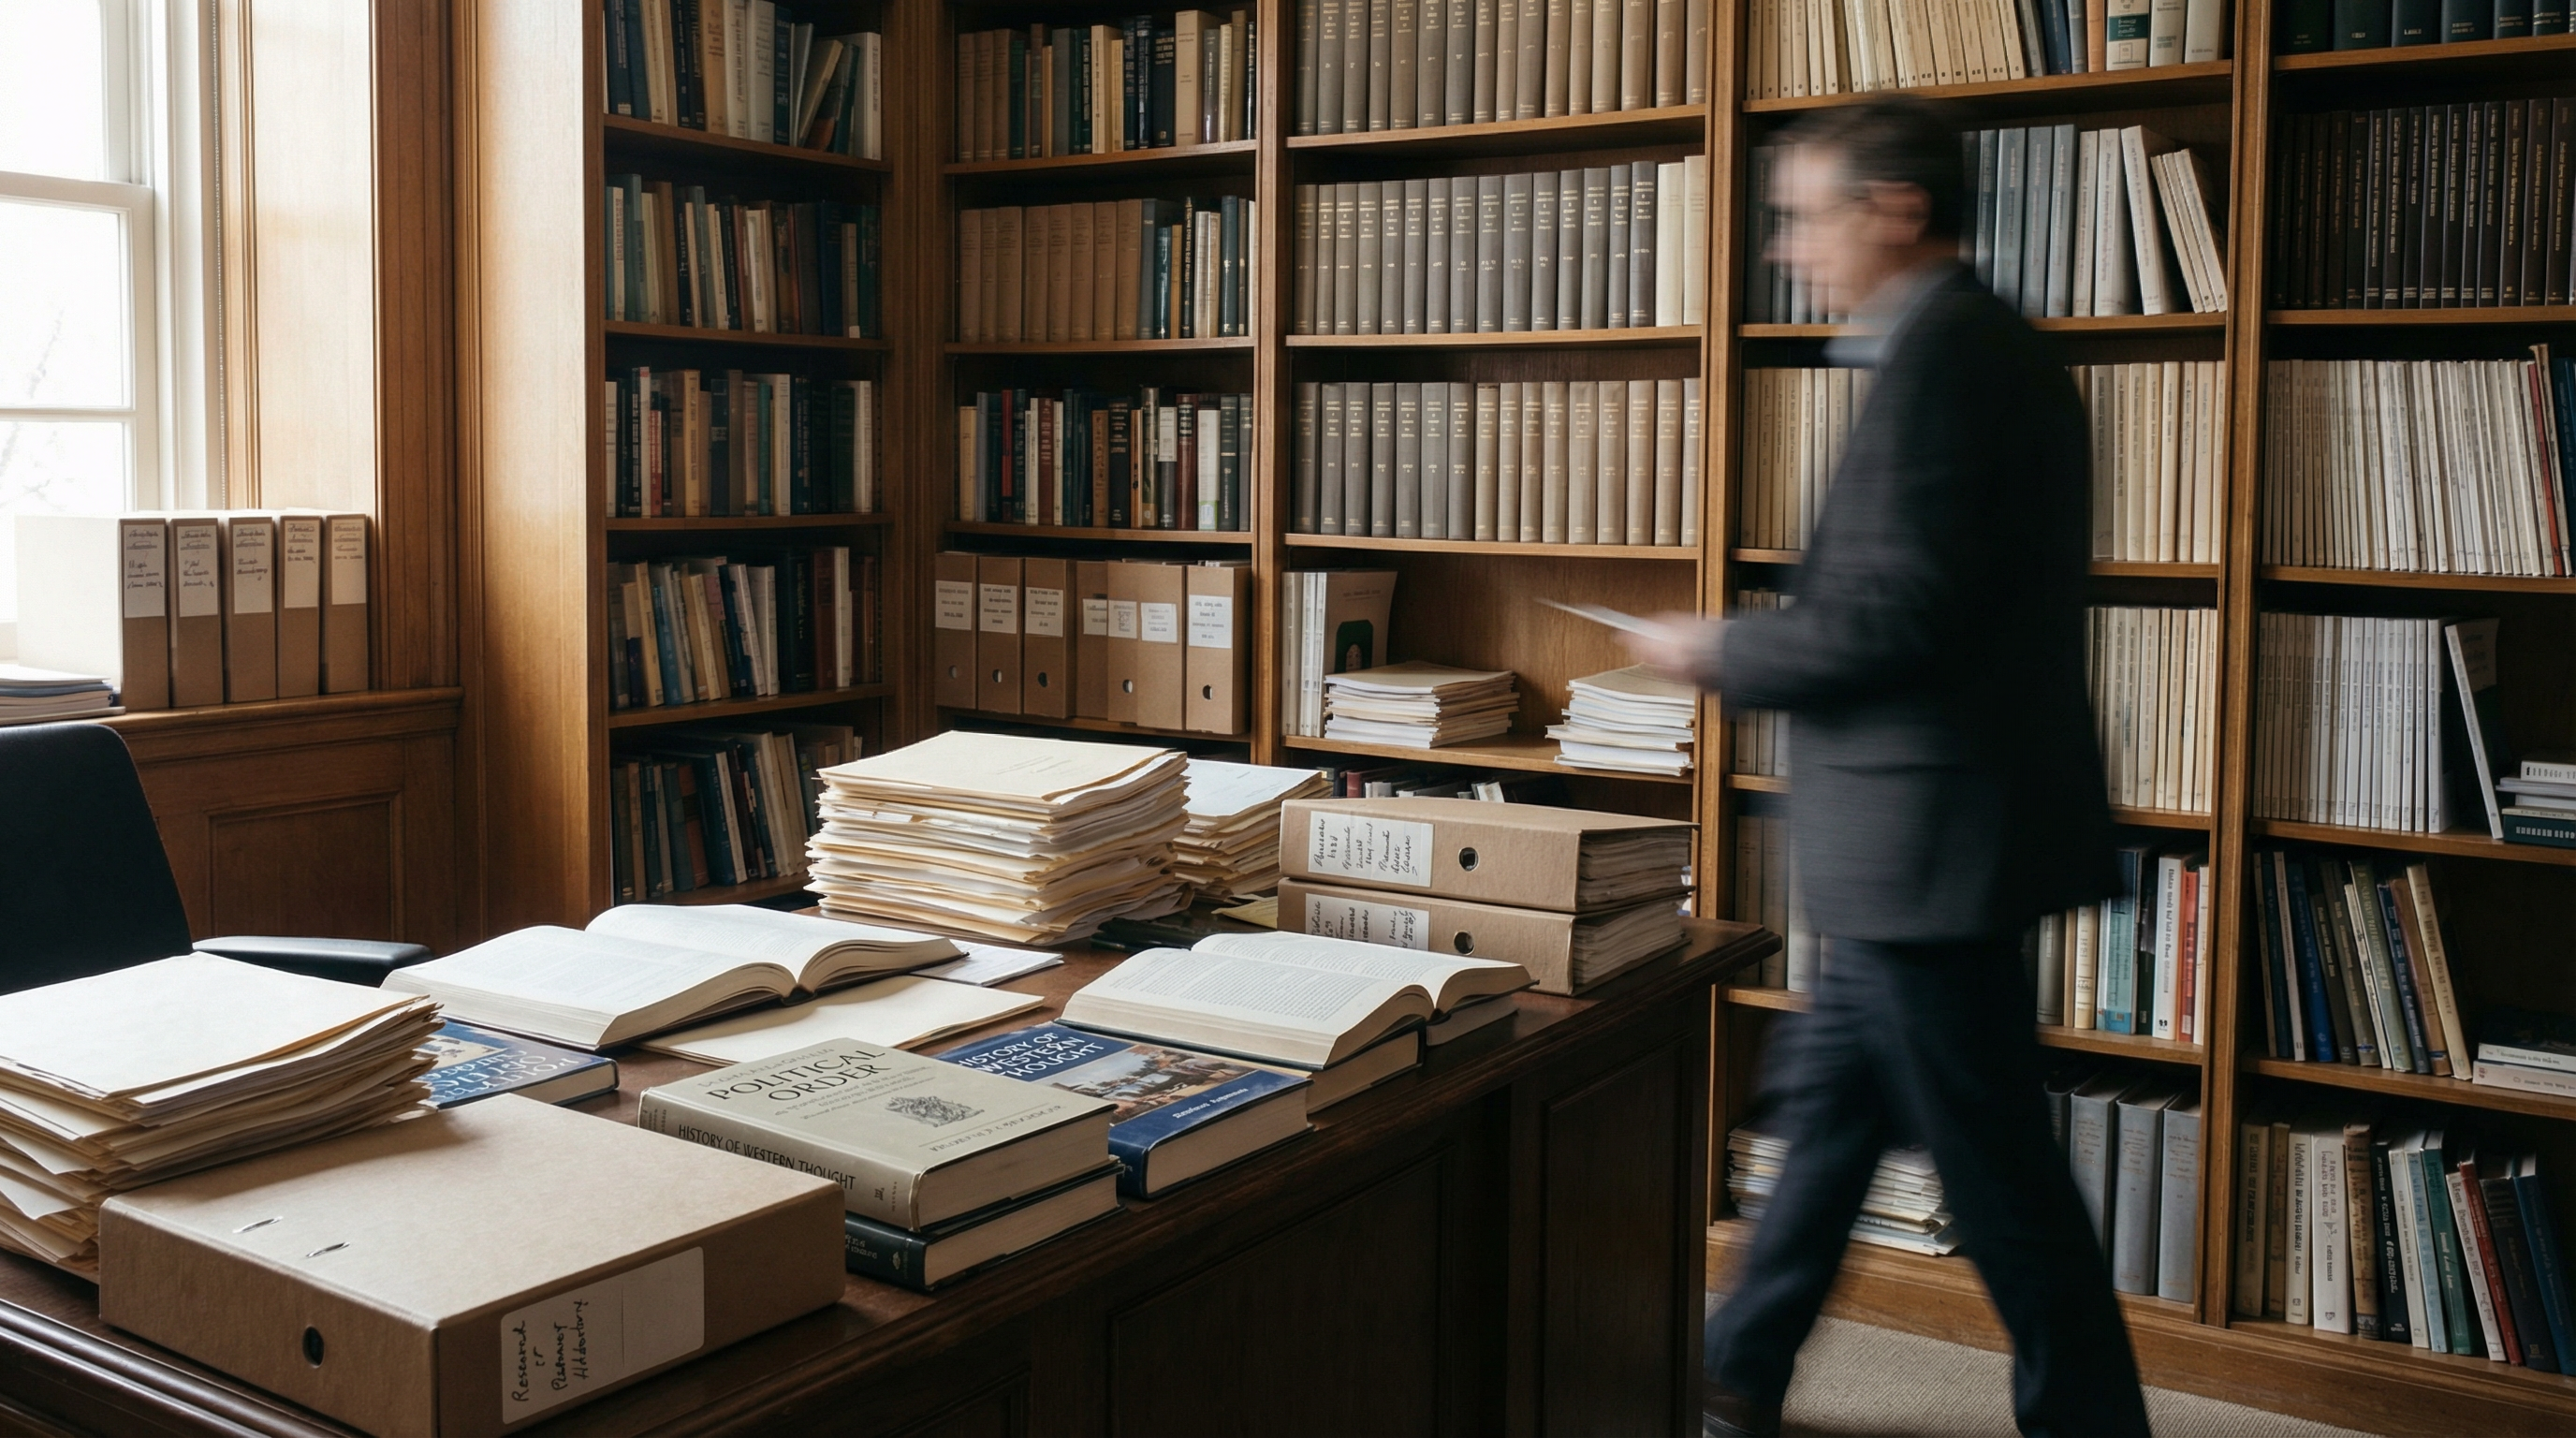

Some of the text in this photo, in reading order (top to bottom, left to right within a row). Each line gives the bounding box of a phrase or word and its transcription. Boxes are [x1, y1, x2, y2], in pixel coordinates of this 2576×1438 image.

[1033, 1032, 1059, 1045] OF
[705, 1049, 886, 1100] POLITICAL
[768, 1064, 892, 1101] ORDER
[679, 1124, 723, 1149] HISTORY
[725, 1138, 740, 1153] OF
